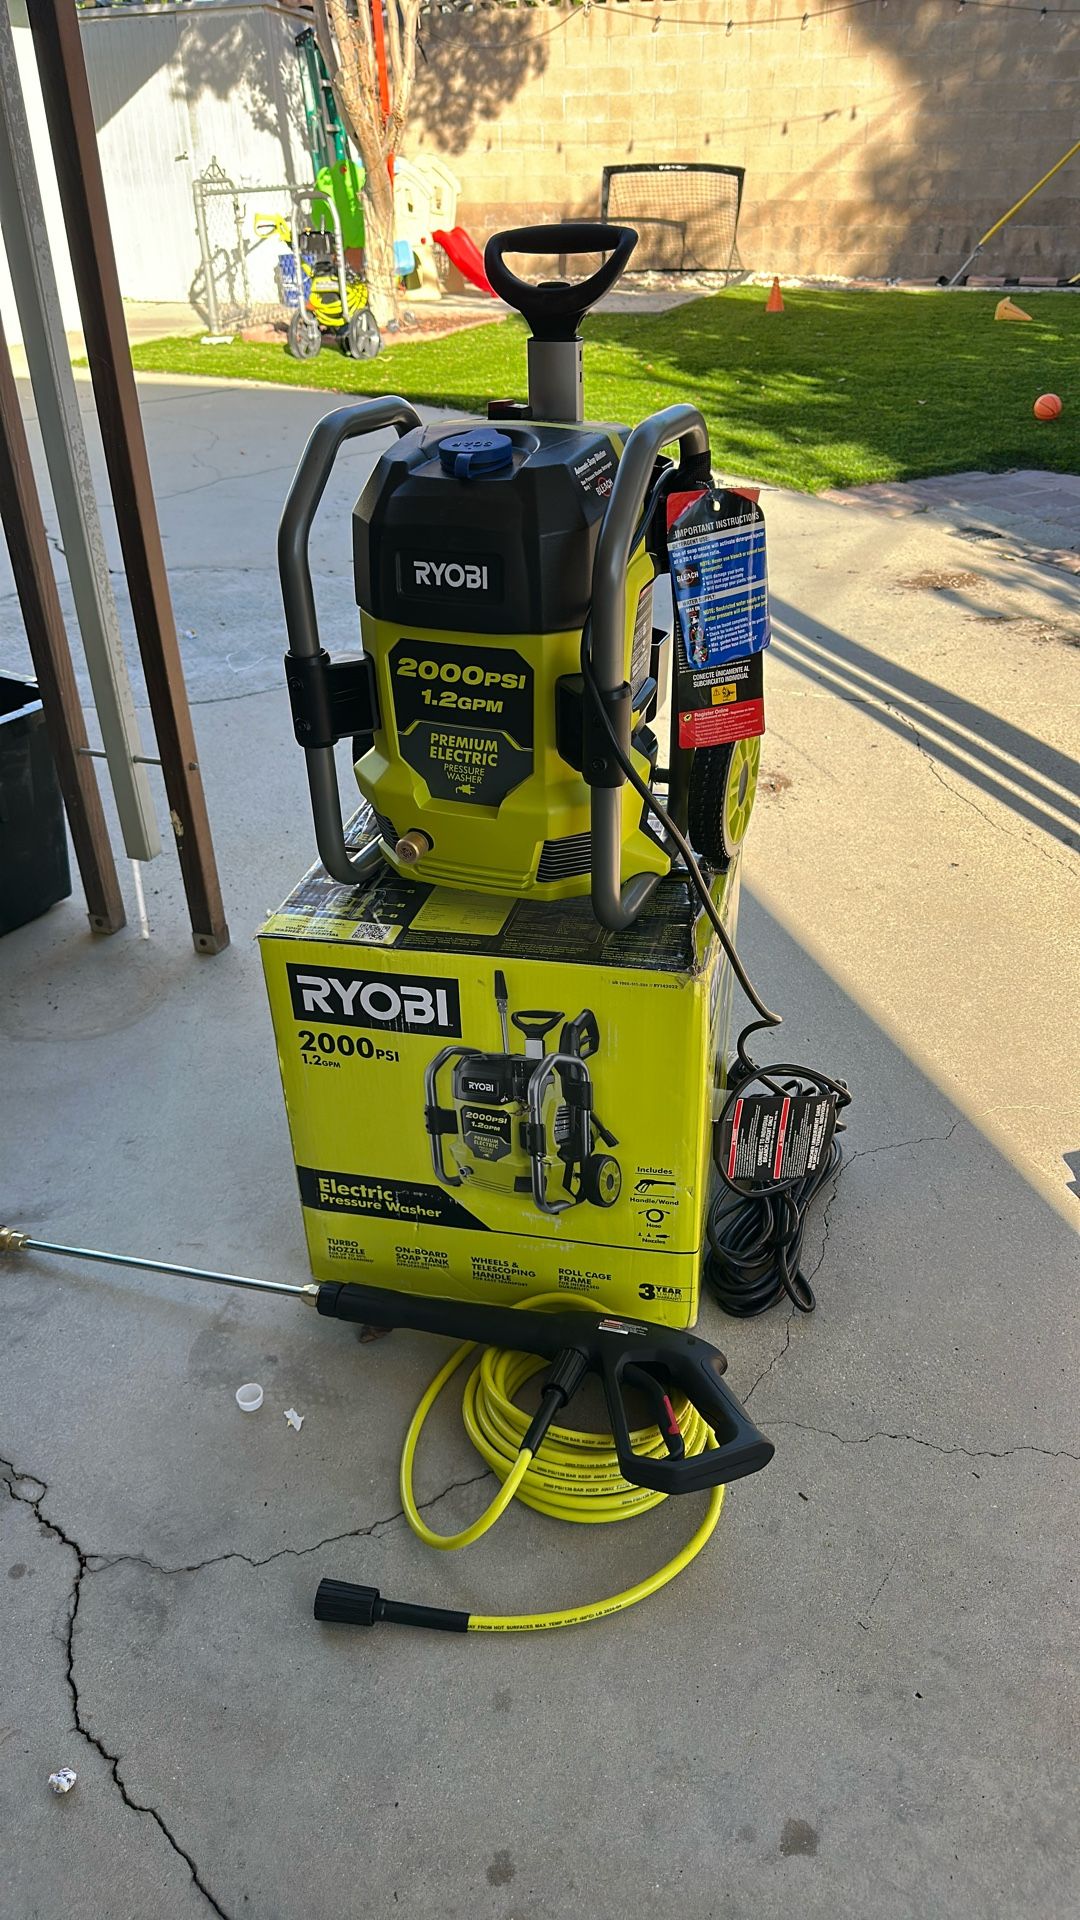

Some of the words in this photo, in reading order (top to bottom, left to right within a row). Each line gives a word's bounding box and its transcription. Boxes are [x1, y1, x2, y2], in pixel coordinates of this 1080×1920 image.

[596, 478, 614, 496] BLEACH
[674, 522, 714, 538] IMPORTANT
[715, 512, 760, 529] INSTRUCTIONS
[720, 538, 735, 547] activate
[414, 561, 488, 589] RYOBI
[677, 571, 699, 583] BLEACH
[713, 571, 727, 579] damage
[714, 582, 728, 590] damage
[717, 611, 733, 620] pressure
[397, 657, 526, 689] 2000PSI
[692, 671, 715, 681] CONECTE
[741, 665, 750, 673] AL
[693, 677, 725, 688] SUBCIRCUITO
[725, 672, 749, 682] INDIVIDUAL
[422, 689, 503, 713] 1.2GPM
[694, 710, 714, 718] Register
[431, 733, 498, 753] PREMIUM
[429, 746, 498, 767] ELECTRIC
[444, 763, 485, 777] PRESSURE
[447, 772, 482, 784] WASHER
[296, 975, 449, 1027] RYOBI
[298, 1030, 400, 1062] 2000PSI
[301, 1053, 341, 1068] 1.2GPM
[468, 1081, 494, 1092] RYOBI
[465, 1111, 508, 1124] 2000PSI
[471, 1121, 500, 1132] 1.2GPM
[473, 1135, 499, 1144] PREMIUM
[473, 1140, 499, 1149] ELECTRIC
[757, 1145, 765, 1166] CONNECT
[762, 1144, 770, 1163] BRANCH
[637, 1166, 673, 1175] Includes
[318, 1178, 393, 1201] Electric
[320, 1193, 382, 1210] Pressure
[386, 1201, 442, 1218] Washer
[630, 1197, 679, 1206] Handle/Wand
[327, 1237, 359, 1248] TURBO
[642, 1237, 666, 1245] Nozzles
[328, 1245, 365, 1255] NOZZLE
[395, 1246, 448, 1259] ON-BOARD
[395, 1252, 421, 1262] SOAP
[424, 1256, 449, 1266] TANK
[471, 1256, 509, 1267] WHEELS
[471, 1263, 537, 1278] TELESCOPING
[472, 1270, 511, 1282] HANDLE
[558, 1268, 583, 1277] ROLL
[585, 1271, 612, 1281] CAGE
[558, 1275, 592, 1285] FRAME
[638, 1283, 656, 1300] 3
[656, 1286, 682, 1295] YEAR
[640, 1432, 661, 1441] SURFACE
